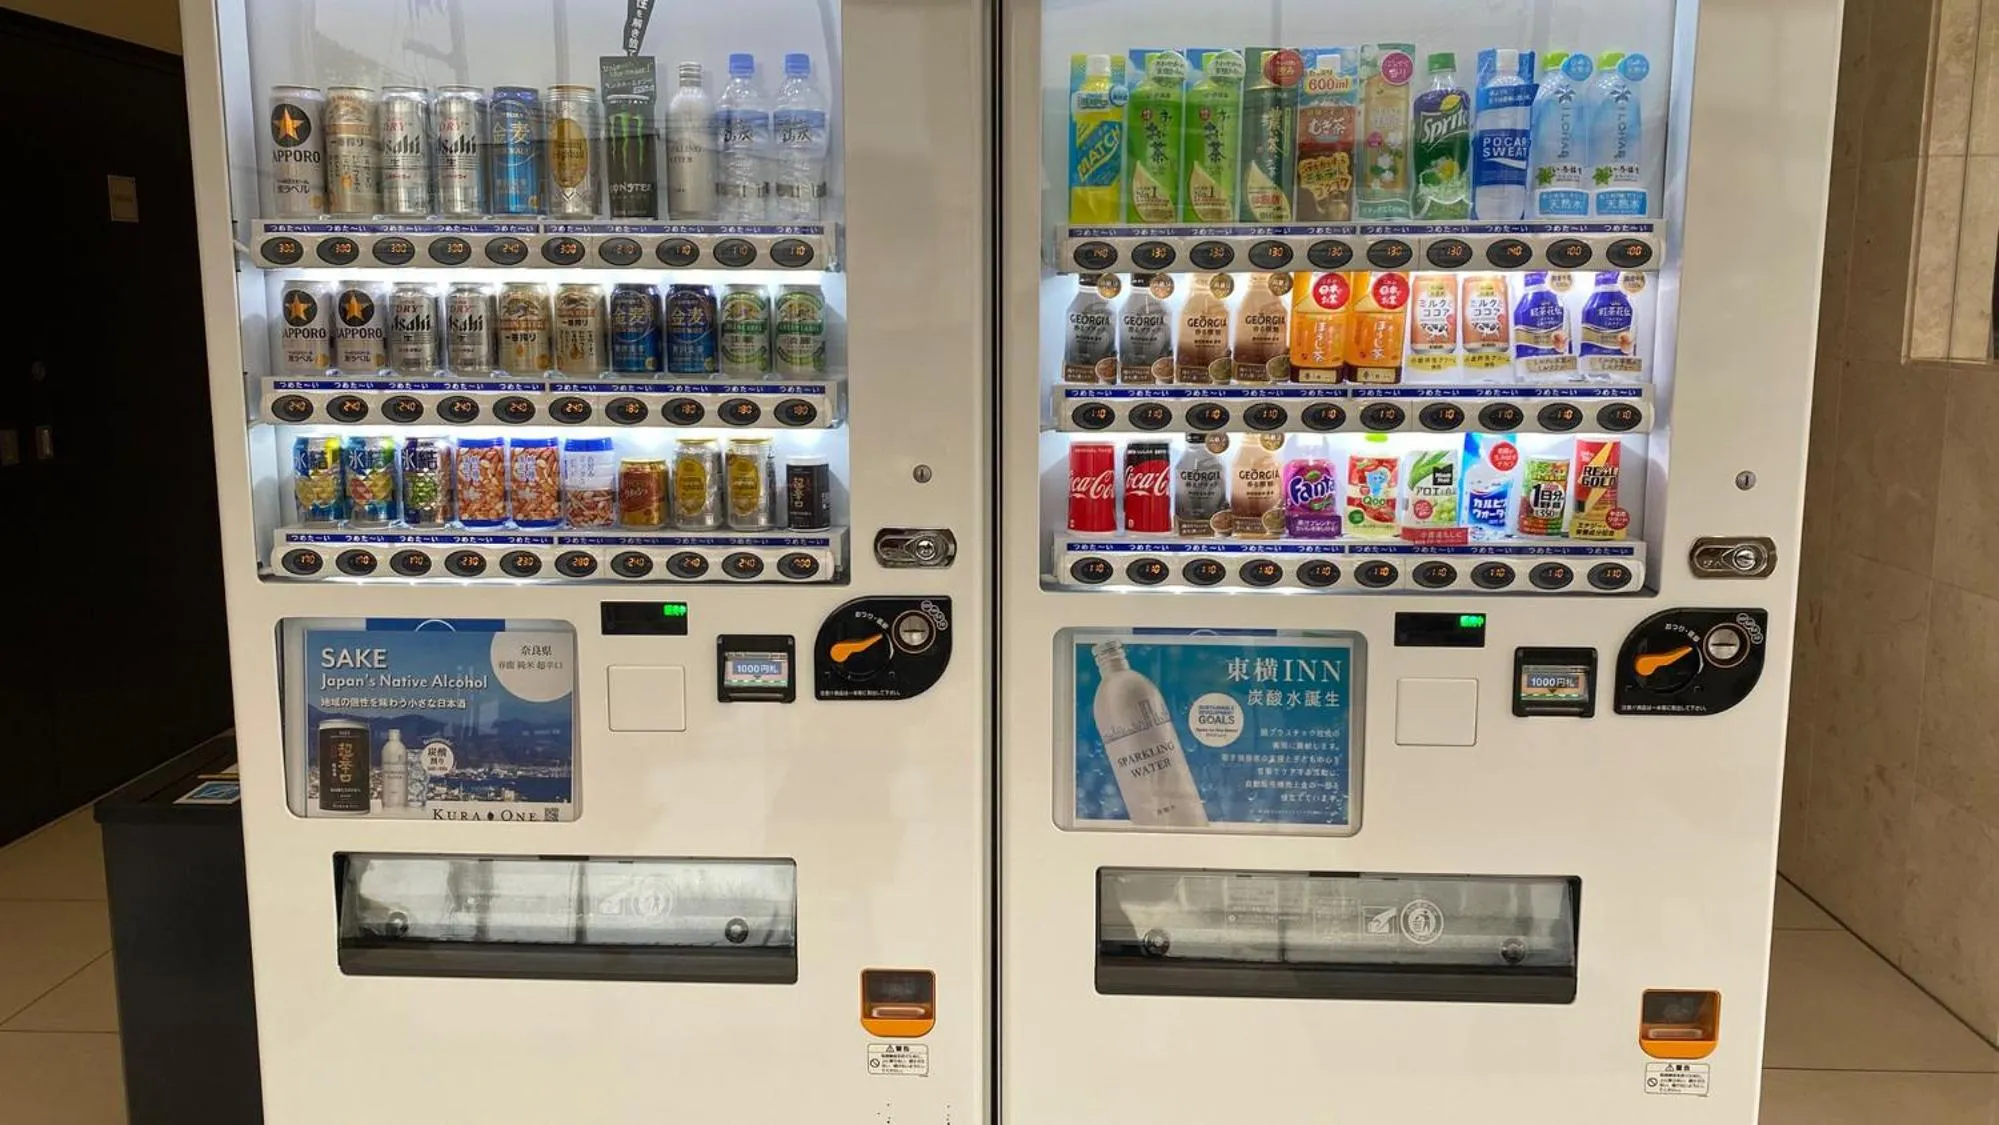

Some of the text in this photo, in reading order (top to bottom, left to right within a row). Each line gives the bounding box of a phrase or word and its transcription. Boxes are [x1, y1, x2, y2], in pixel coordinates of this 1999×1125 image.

[1308, 78, 1349, 90] 600ml
[1152, 248, 1167, 257] 130
[1268, 248, 1283, 257] 130
[1070, 313, 1110, 326] GEORGIA
[1124, 313, 1164, 326] GEORGIA
[400, 401, 416, 412] 240
[454, 402, 472, 412] 240
[510, 402, 527, 413] 240
[1180, 471, 1221, 481] GEORGIA
[1239, 470, 1280, 480] GEORGIA
[1583, 465, 1619, 476] REAL
[1582, 476, 1618, 488] GOLD
[1290, 475, 1336, 506] Fanta
[1363, 496, 1386, 506] Qoo
[520, 644, 552, 656] 奈良県
[321, 648, 388, 669] SAKE
[737, 663, 779, 674] 1000円札
[1226, 657, 1343, 683] 東横INN
[320, 673, 488, 691] Japan's Native Alcohol
[1530, 676, 1576, 688] 1000円札
[1247, 689, 1341, 708] 炭酸水誕生
[1198, 715, 1235, 725] GOALS
[1117, 741, 1175, 768] SPARKLING
[1130, 757, 1172, 778] WATER
